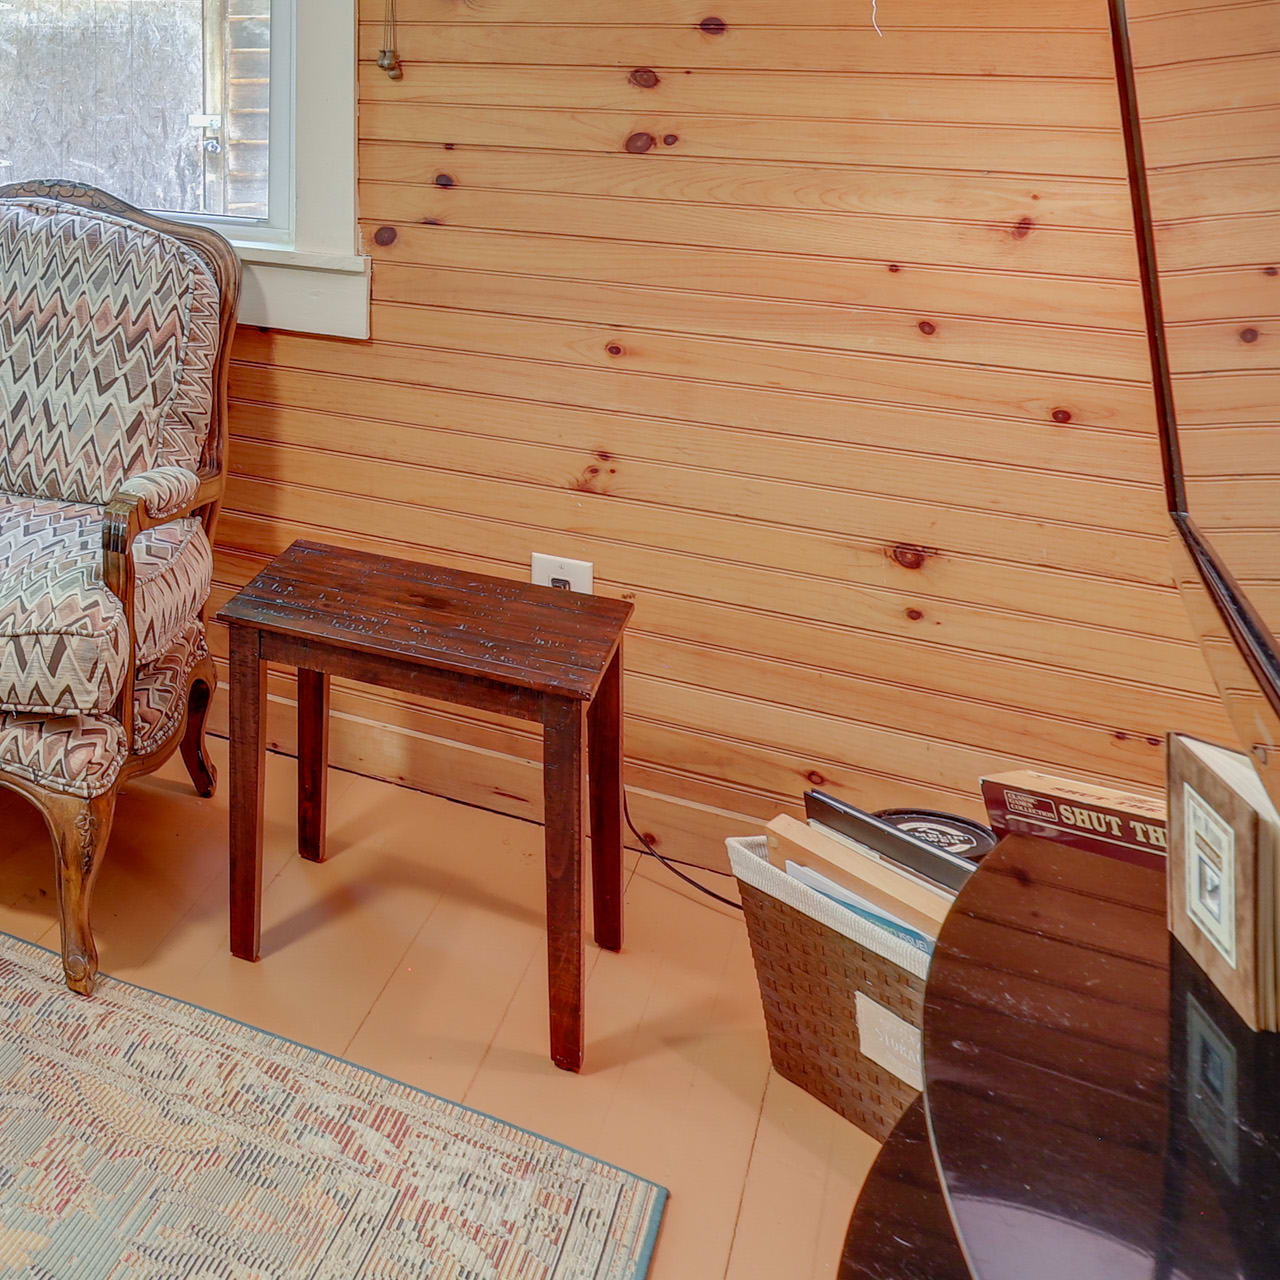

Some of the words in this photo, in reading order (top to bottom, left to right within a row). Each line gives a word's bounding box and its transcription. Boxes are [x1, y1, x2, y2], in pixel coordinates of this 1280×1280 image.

[1010, 803, 1055, 819] COLLECTION
[1059, 804, 1123, 837] SHUT
[1129, 820, 1168, 848] TH
